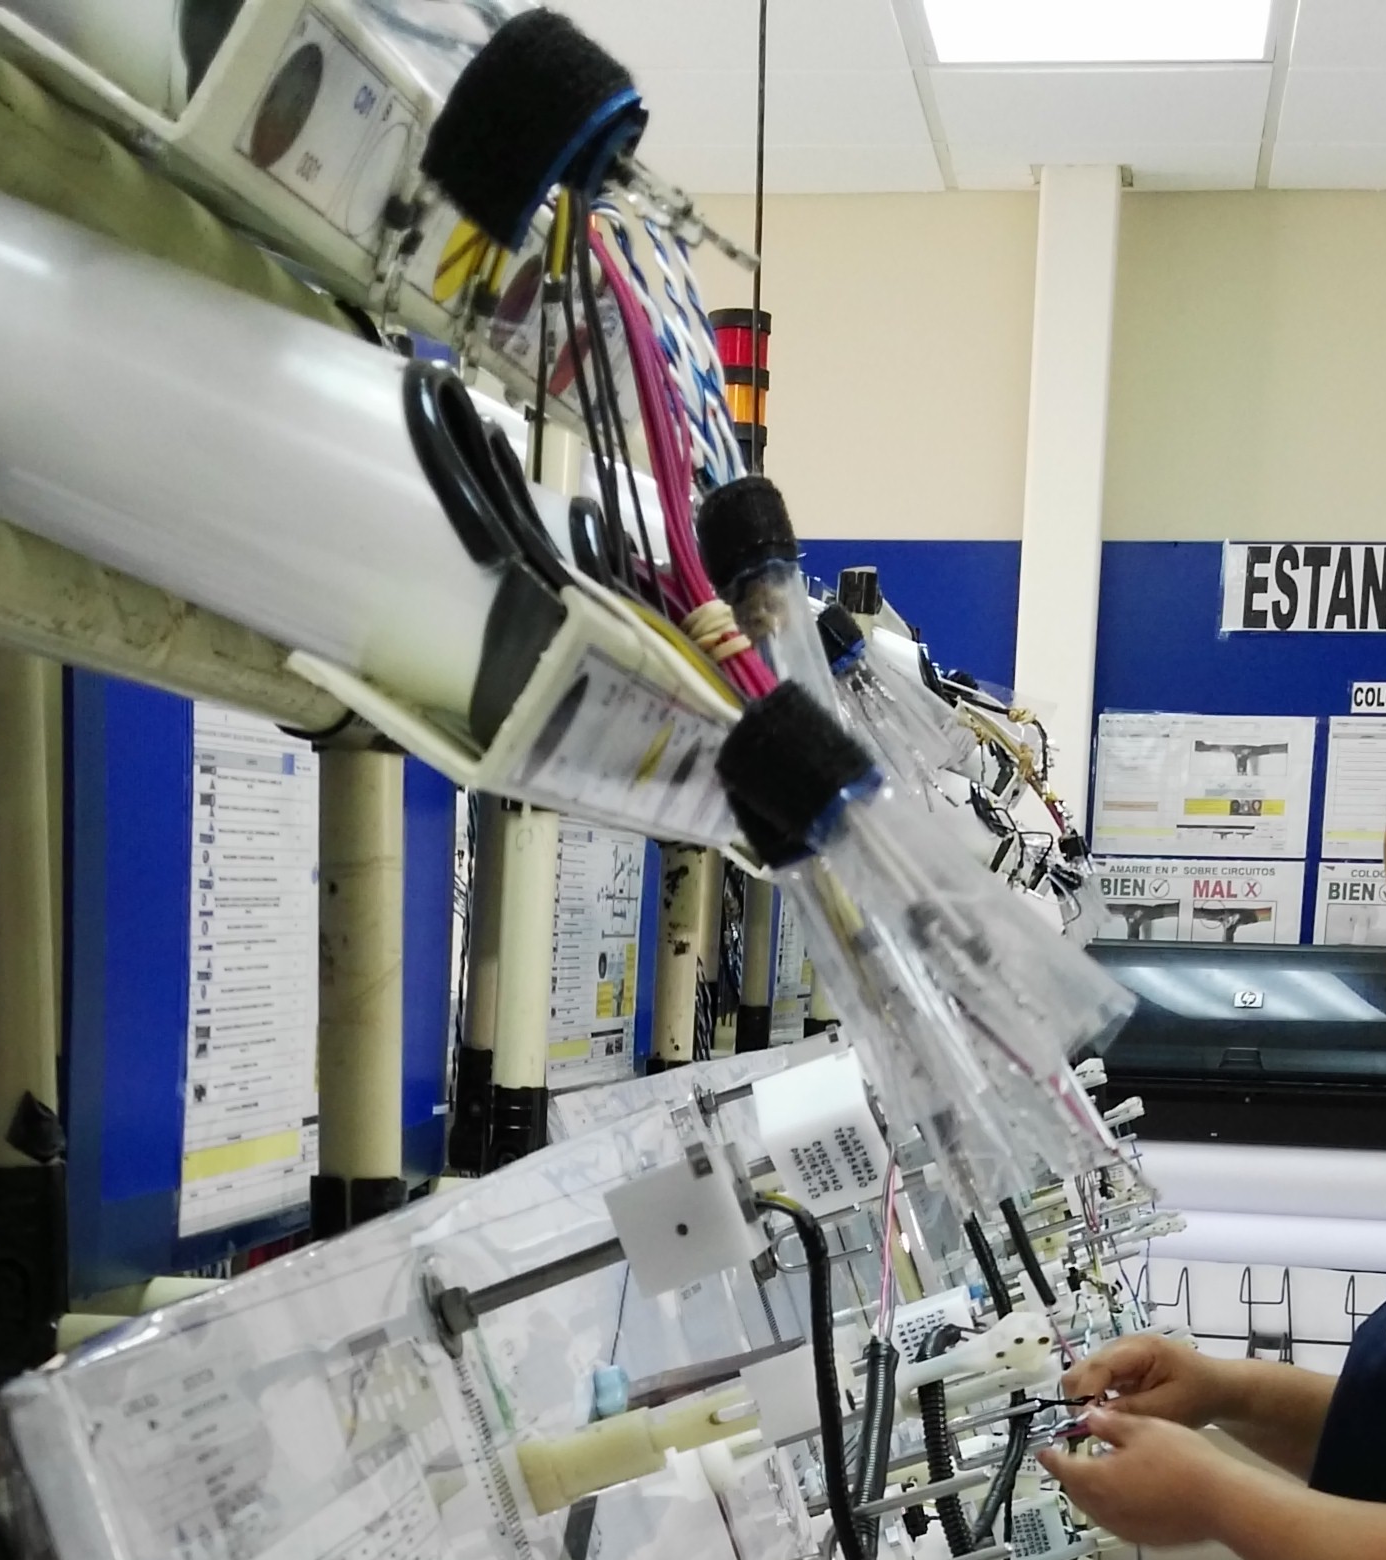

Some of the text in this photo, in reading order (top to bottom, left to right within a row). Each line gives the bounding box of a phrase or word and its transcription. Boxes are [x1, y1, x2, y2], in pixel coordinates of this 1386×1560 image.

[1109, 866, 1151, 875] AMARRE
[1155, 866, 1169, 875] EN
[1183, 867, 1218, 876] SOBRE
[1221, 867, 1276, 877] CIRCUITOS
[1100, 878, 1238, 899] BIEN MAL
[1327, 882, 1376, 901] BIEN
[846, 1126, 877, 1181] PLASTIMAQ
